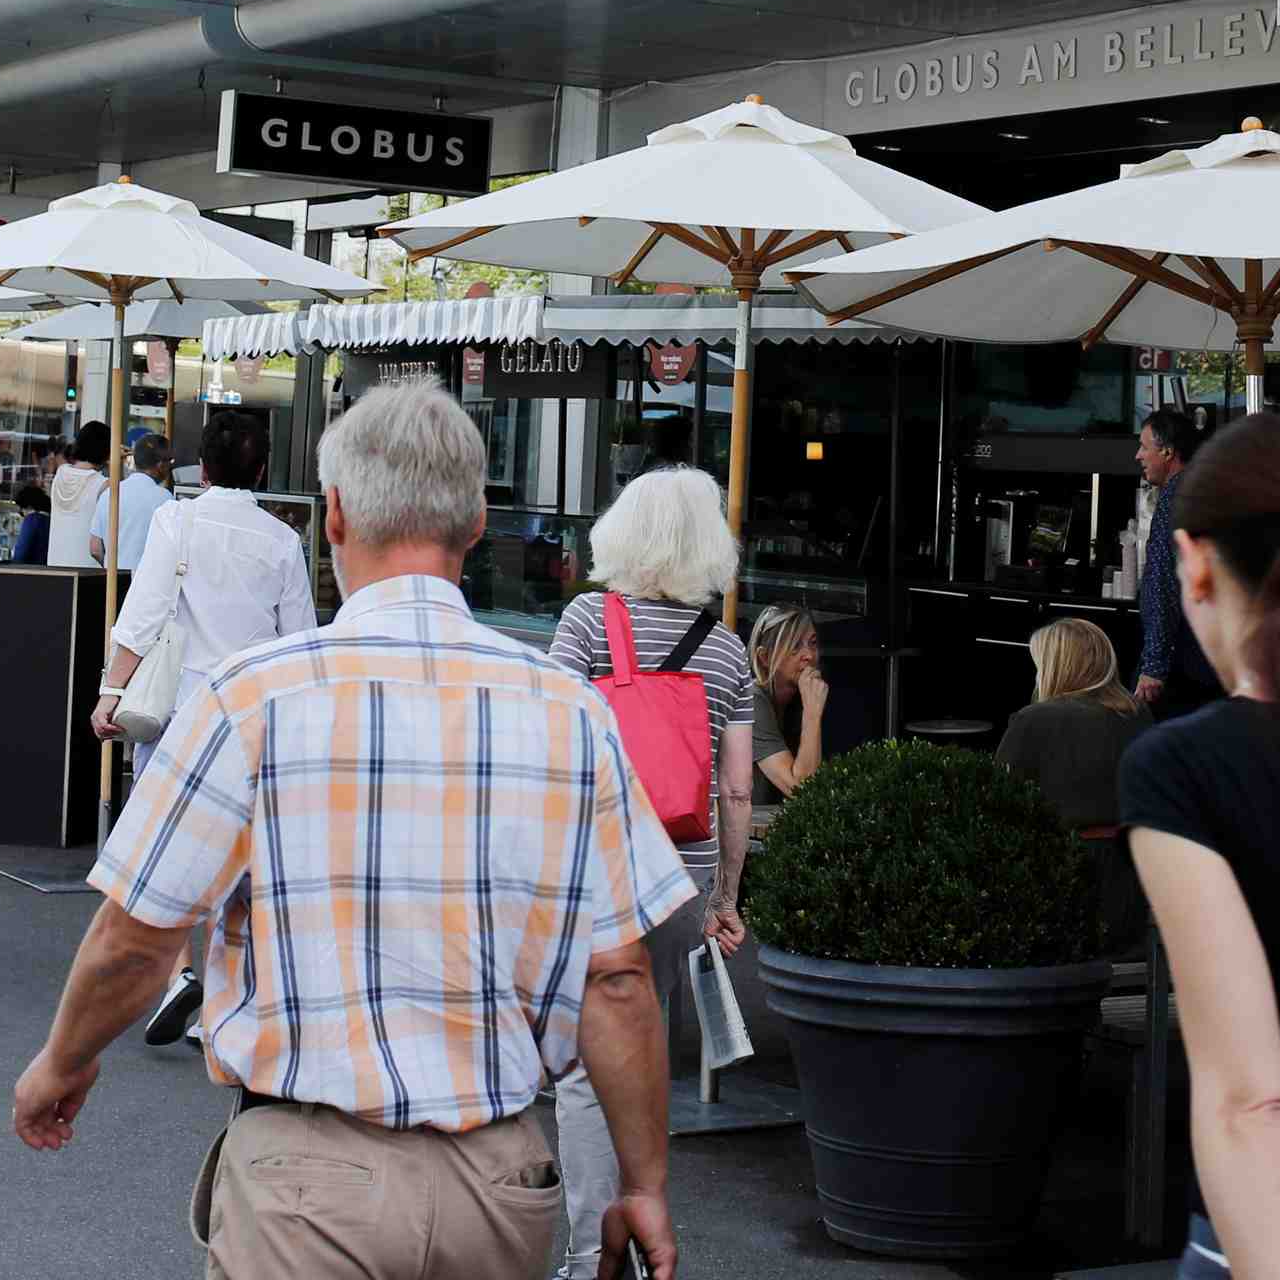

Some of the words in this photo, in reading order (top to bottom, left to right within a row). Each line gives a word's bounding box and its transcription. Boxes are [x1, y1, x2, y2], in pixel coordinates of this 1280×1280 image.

[845, 48, 1000, 107] GLOBUS
[1019, 38, 1080, 86] AM
[261, 118, 465, 167] GLOBUS
[500, 341, 581, 373] GELATO
